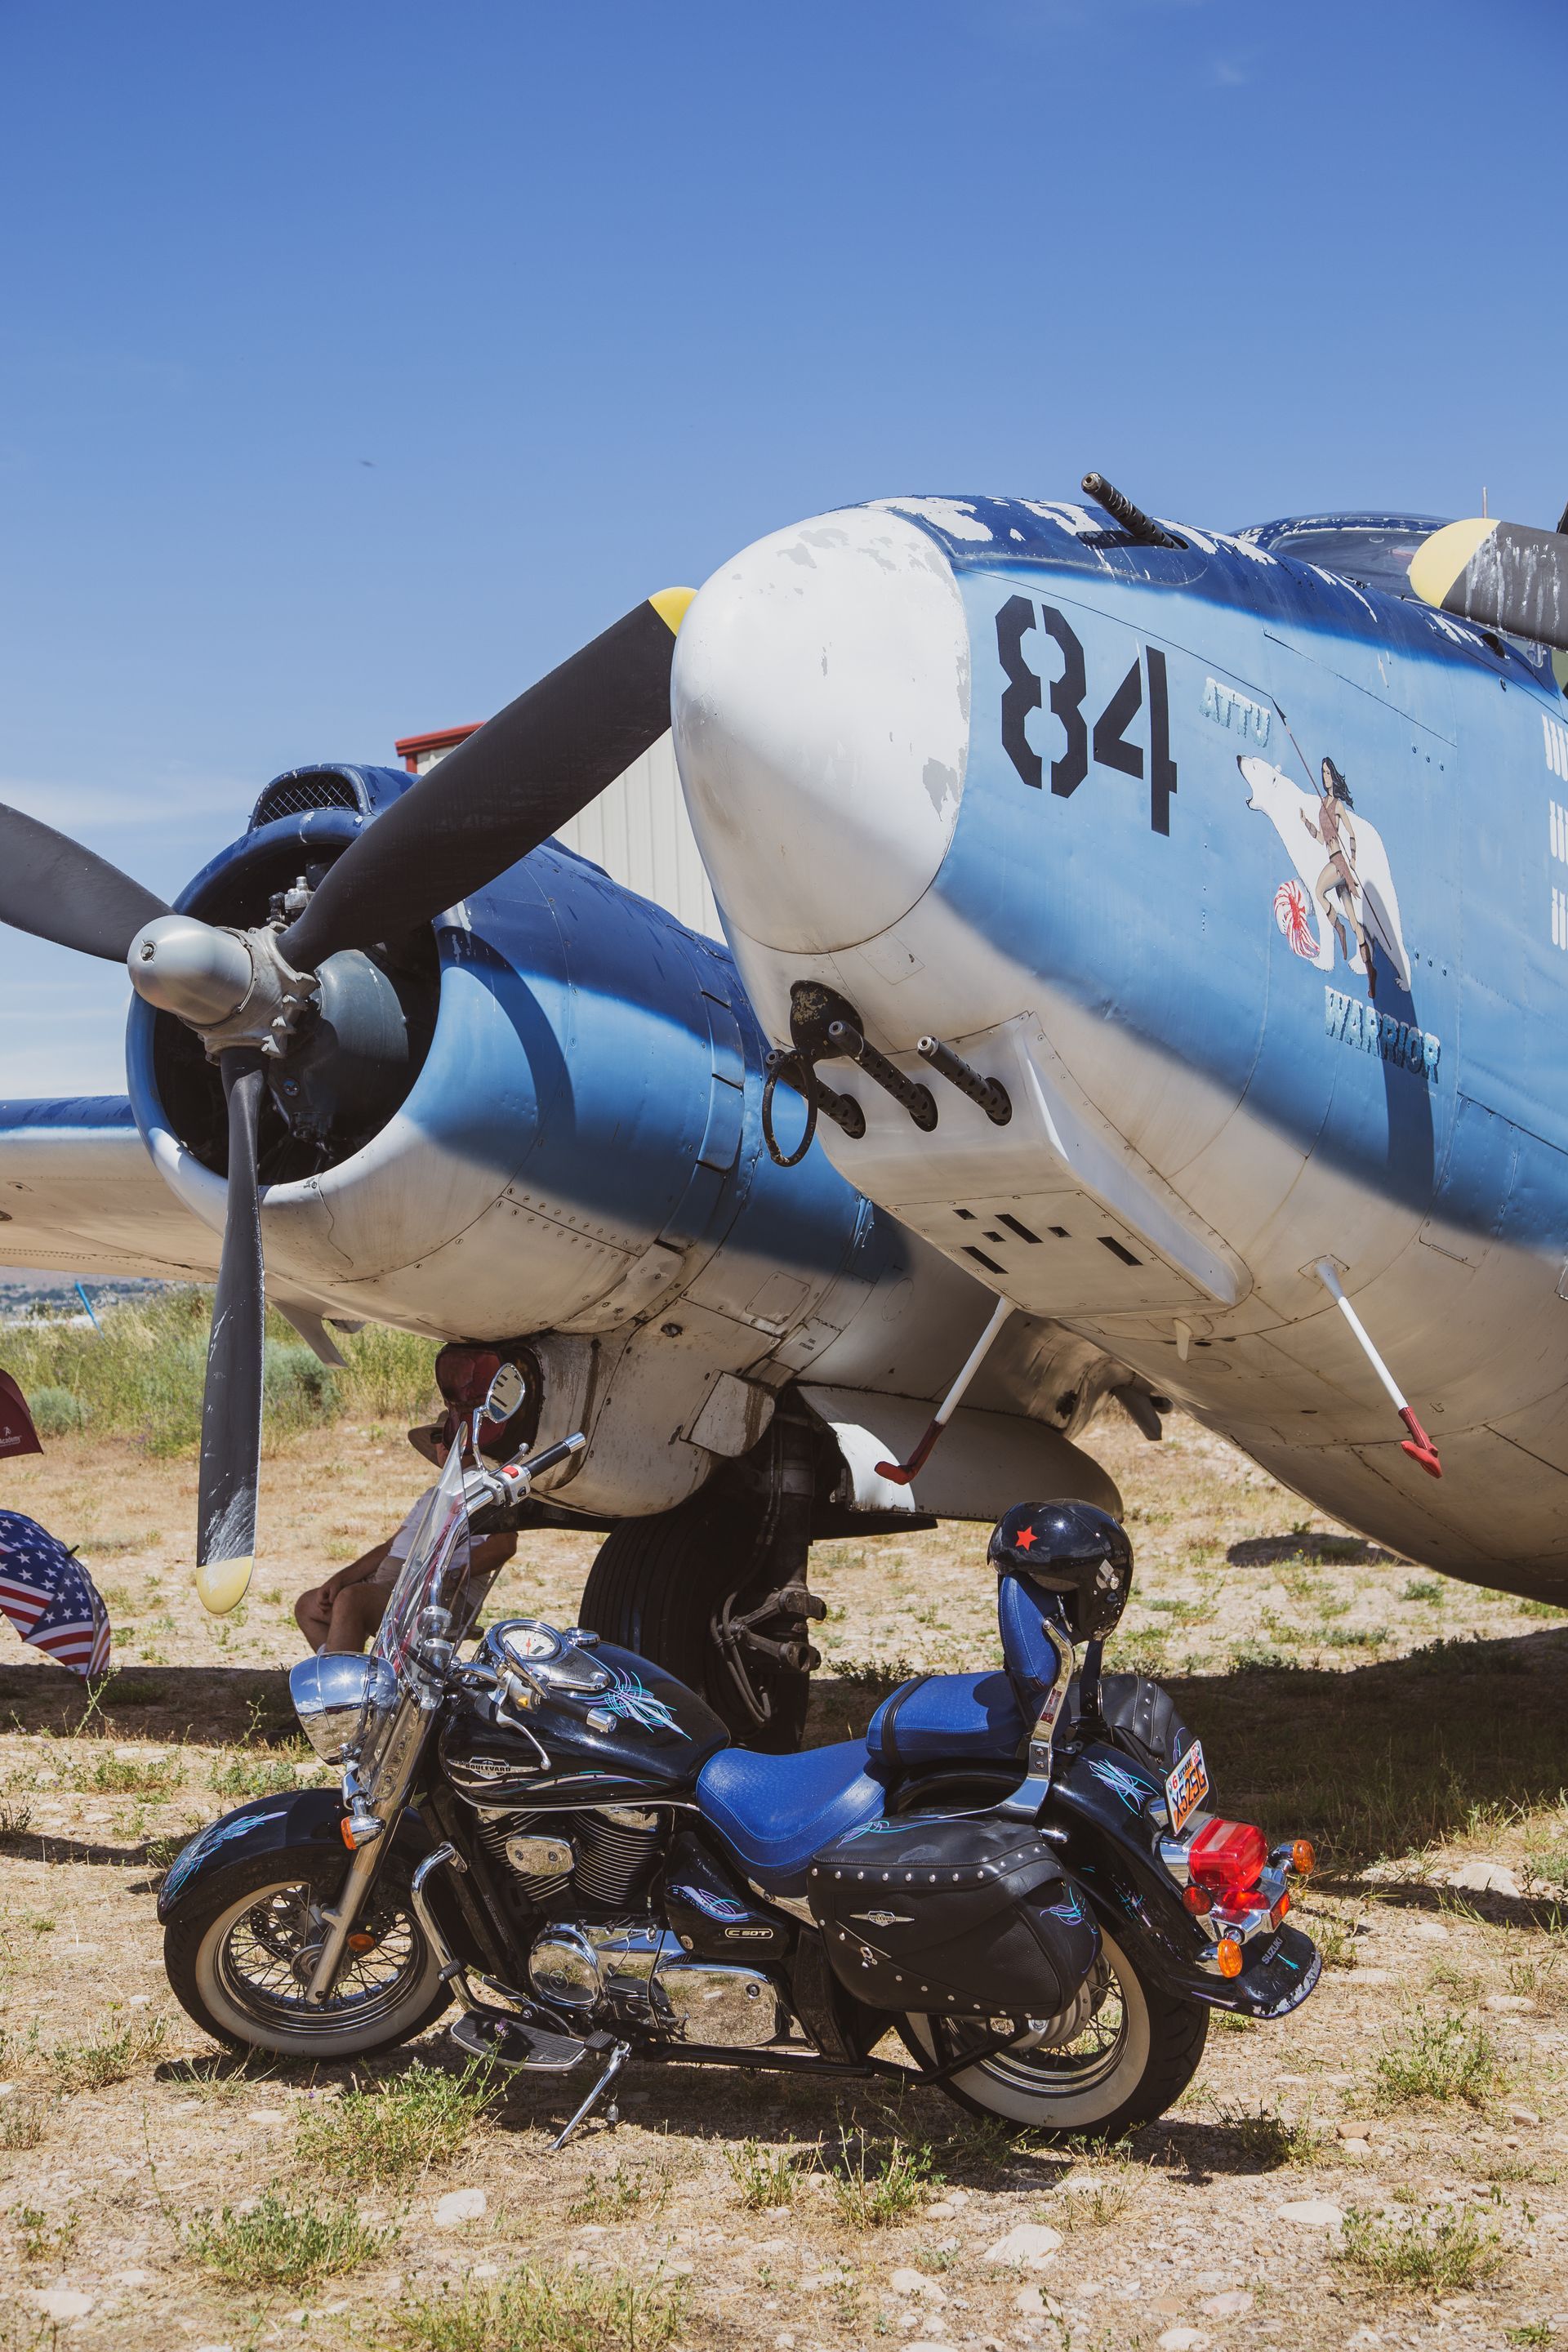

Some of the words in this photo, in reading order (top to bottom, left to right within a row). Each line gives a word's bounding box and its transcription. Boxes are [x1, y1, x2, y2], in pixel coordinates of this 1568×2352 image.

[995, 594, 1178, 838] 84
[1198, 676, 1272, 748] ATTU
[1324, 985, 1441, 1085] WARRIOR
[465, 1762, 511, 1773] BOULEVARD
[1171, 1775, 1178, 1789] 6
[1178, 1758, 1192, 1780] UTAH
[1261, 1936, 1283, 1965] SUZUKI
